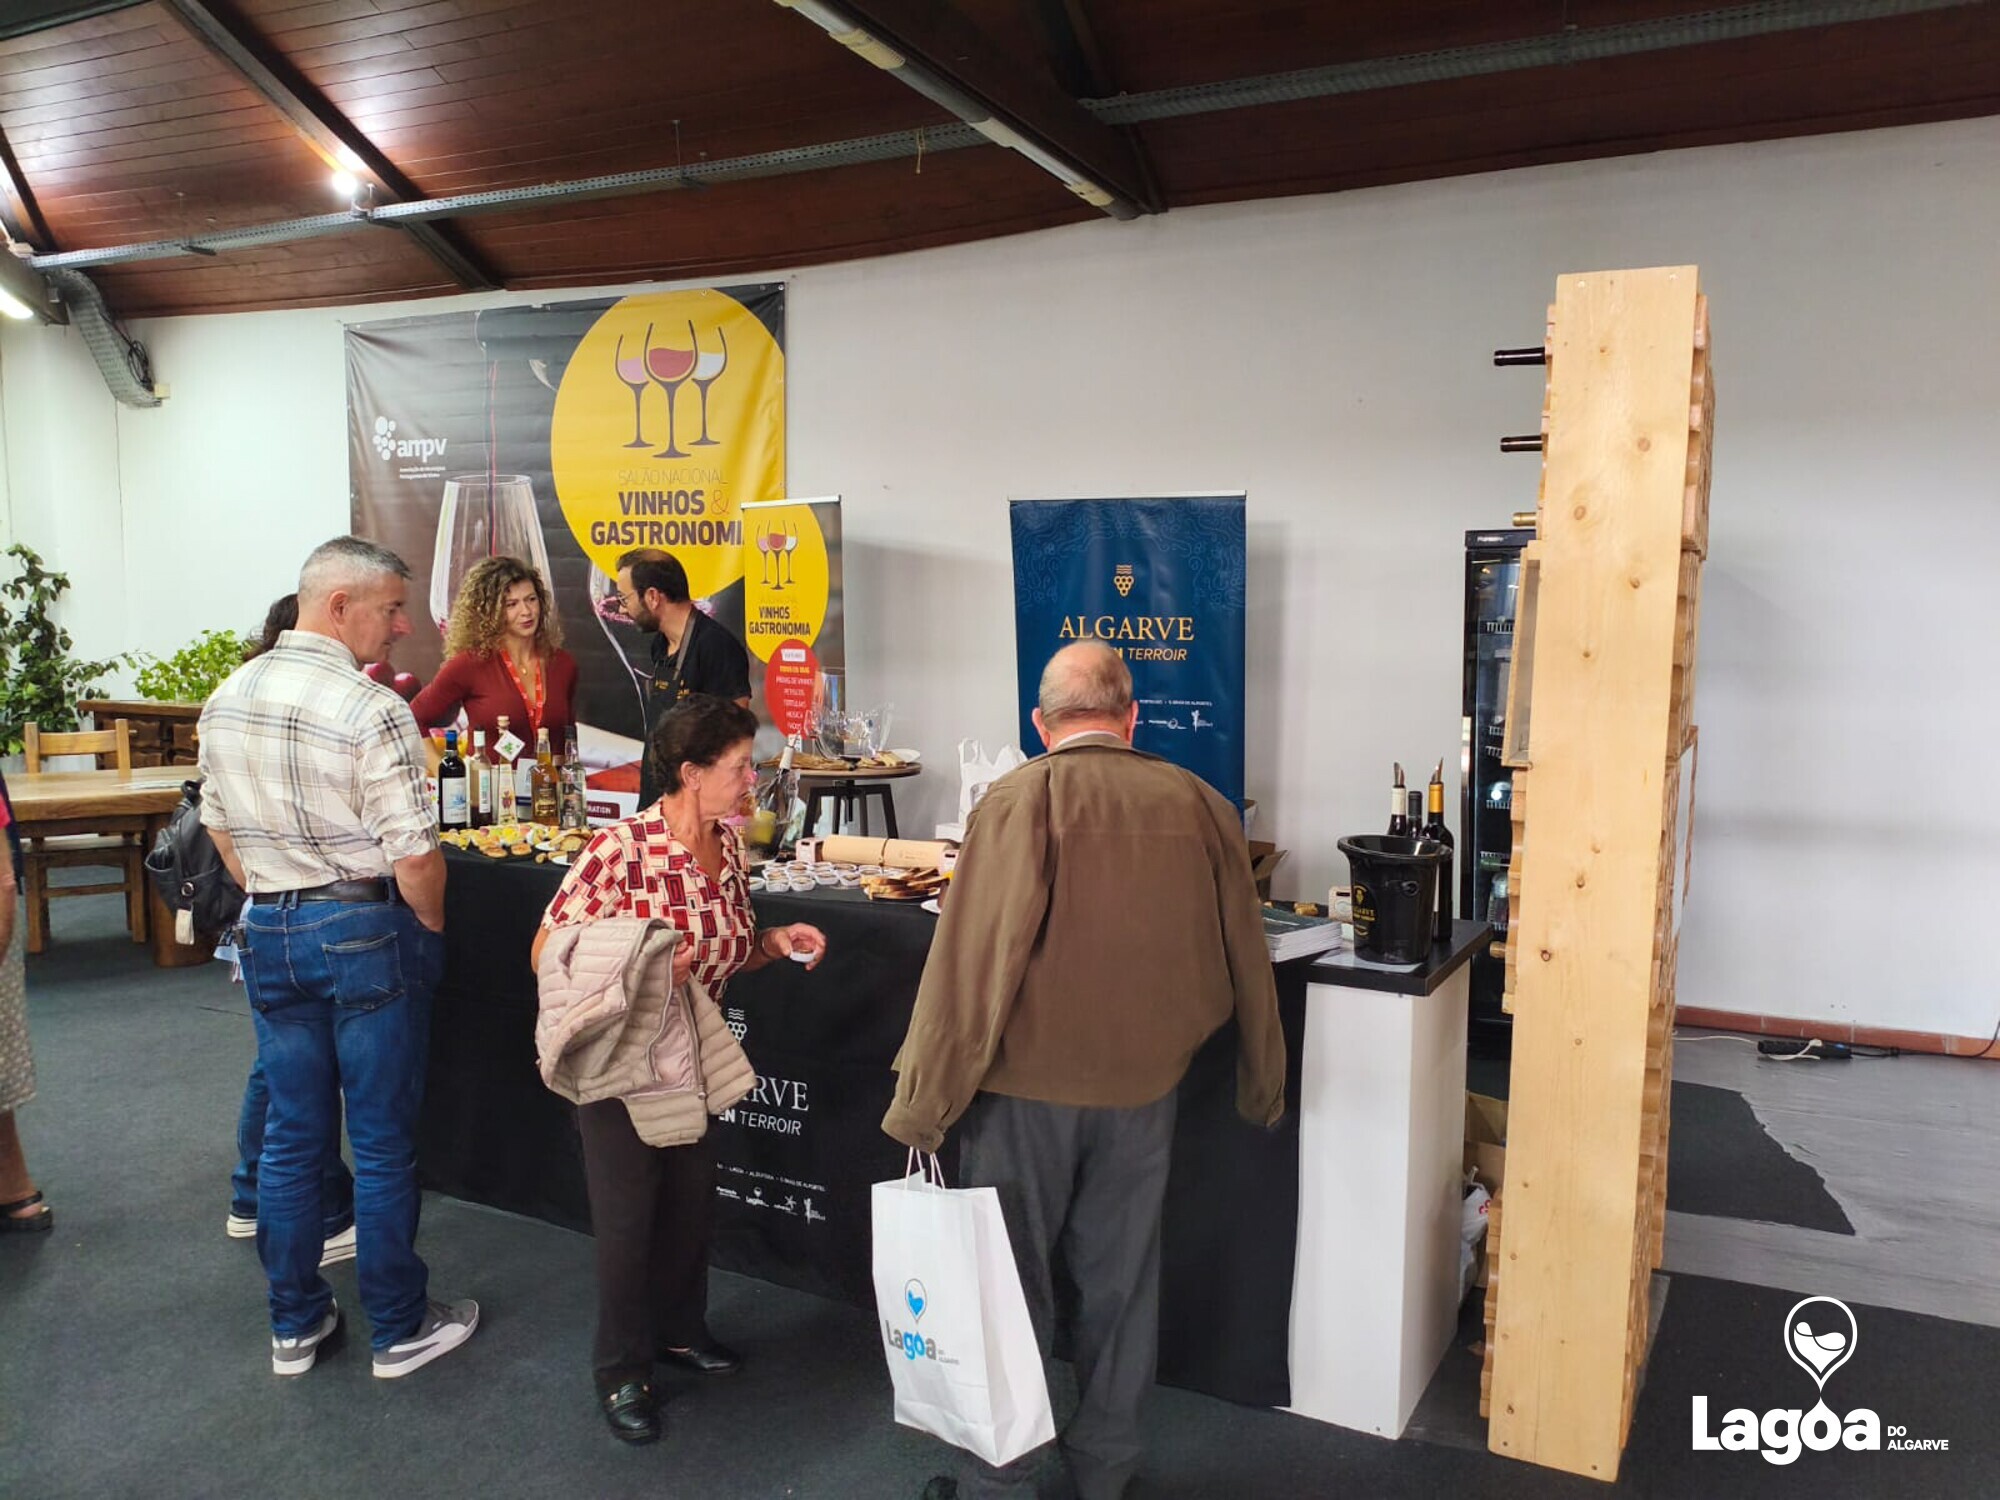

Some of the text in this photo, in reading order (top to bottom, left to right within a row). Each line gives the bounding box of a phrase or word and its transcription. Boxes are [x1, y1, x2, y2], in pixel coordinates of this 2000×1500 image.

[618, 489, 730, 516] VINHOS &
[591, 519, 742, 546] GASTRONOMI
[759, 606, 790, 619] VINHOS
[749, 621, 811, 636] GASTRONOMIA
[1059, 615, 1195, 641] ALGARVE
[1128, 647, 1187, 661] TERROIR
[740, 1110, 802, 1136] TERROIR
[885, 1320, 937, 1361] Lagoa
